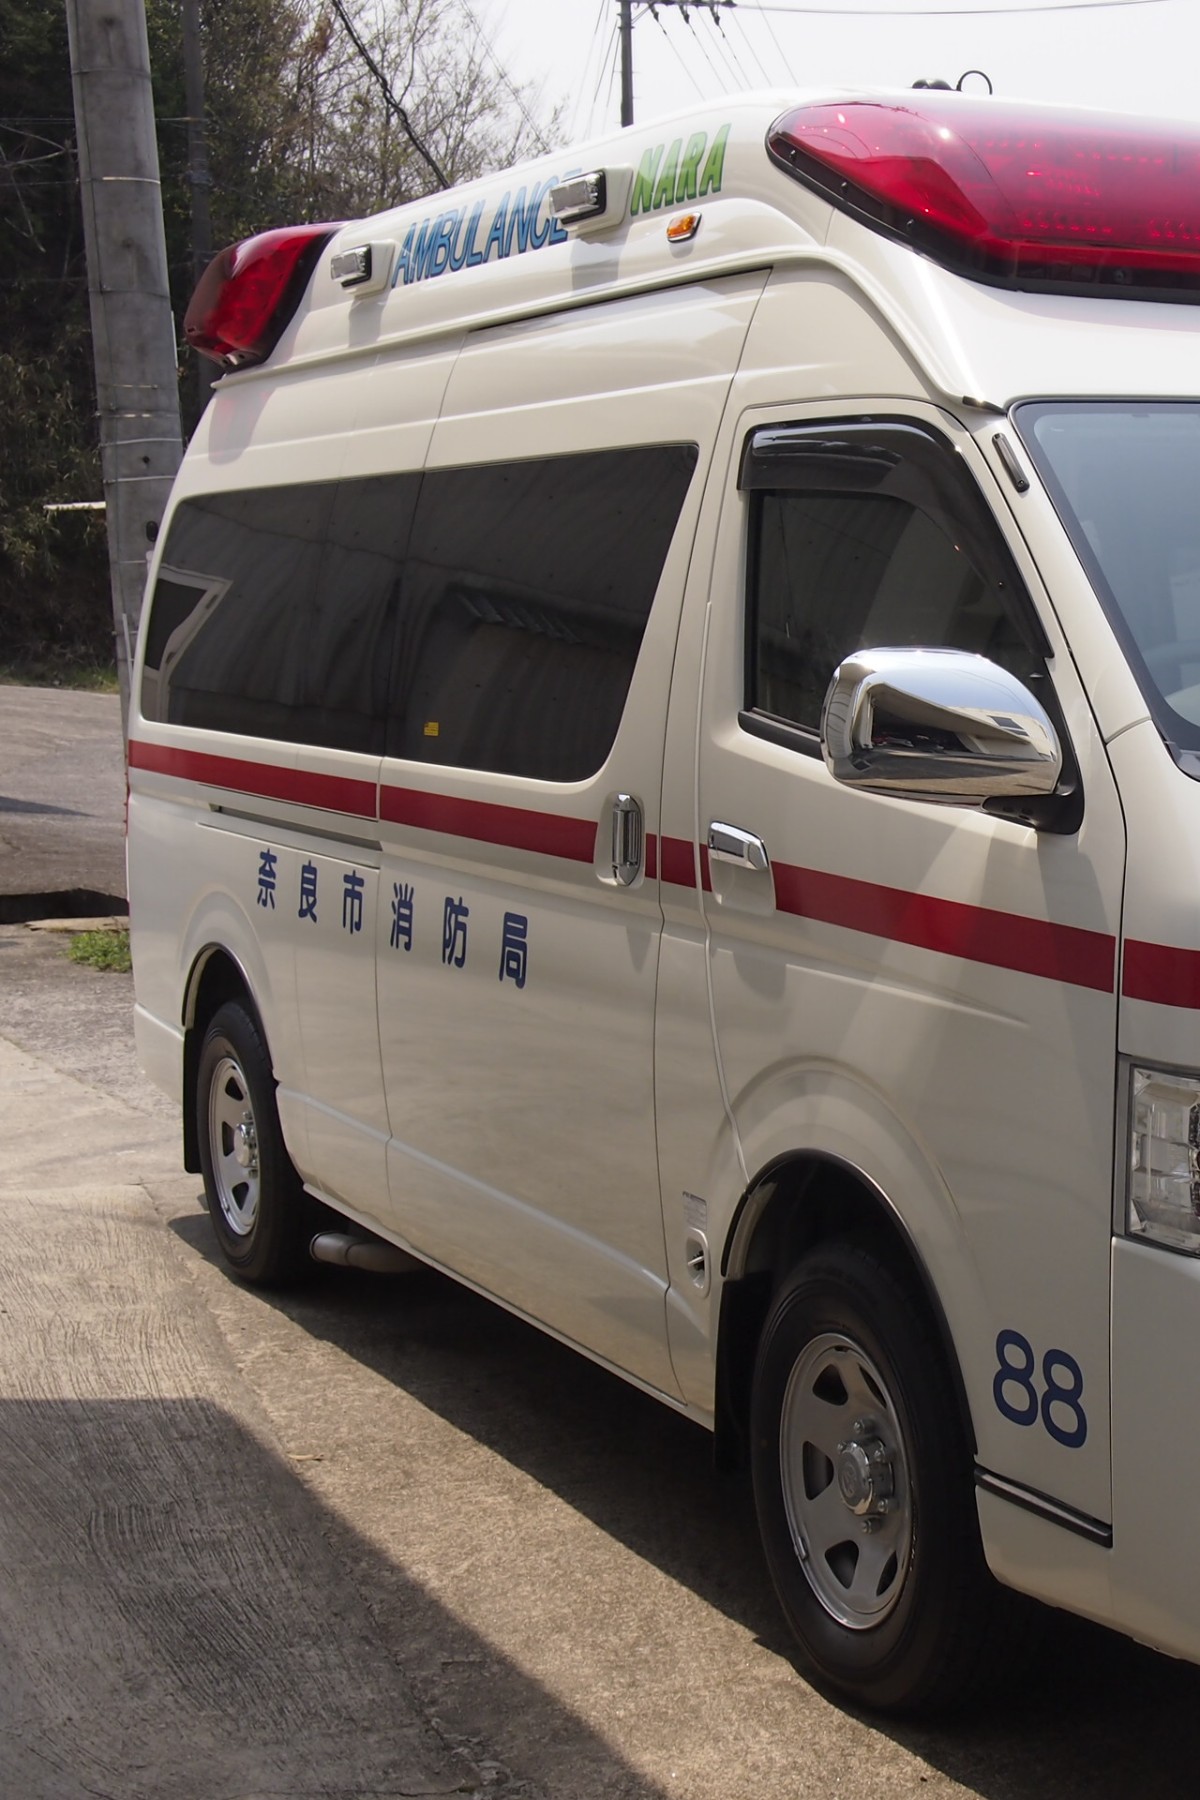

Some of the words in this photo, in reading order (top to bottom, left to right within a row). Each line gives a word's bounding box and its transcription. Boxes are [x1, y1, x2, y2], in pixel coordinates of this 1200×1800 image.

[630, 123, 732, 216] NARA
[257, 848, 529, 989] 奈良市消防局
[993, 1329, 1087, 1448] 88
